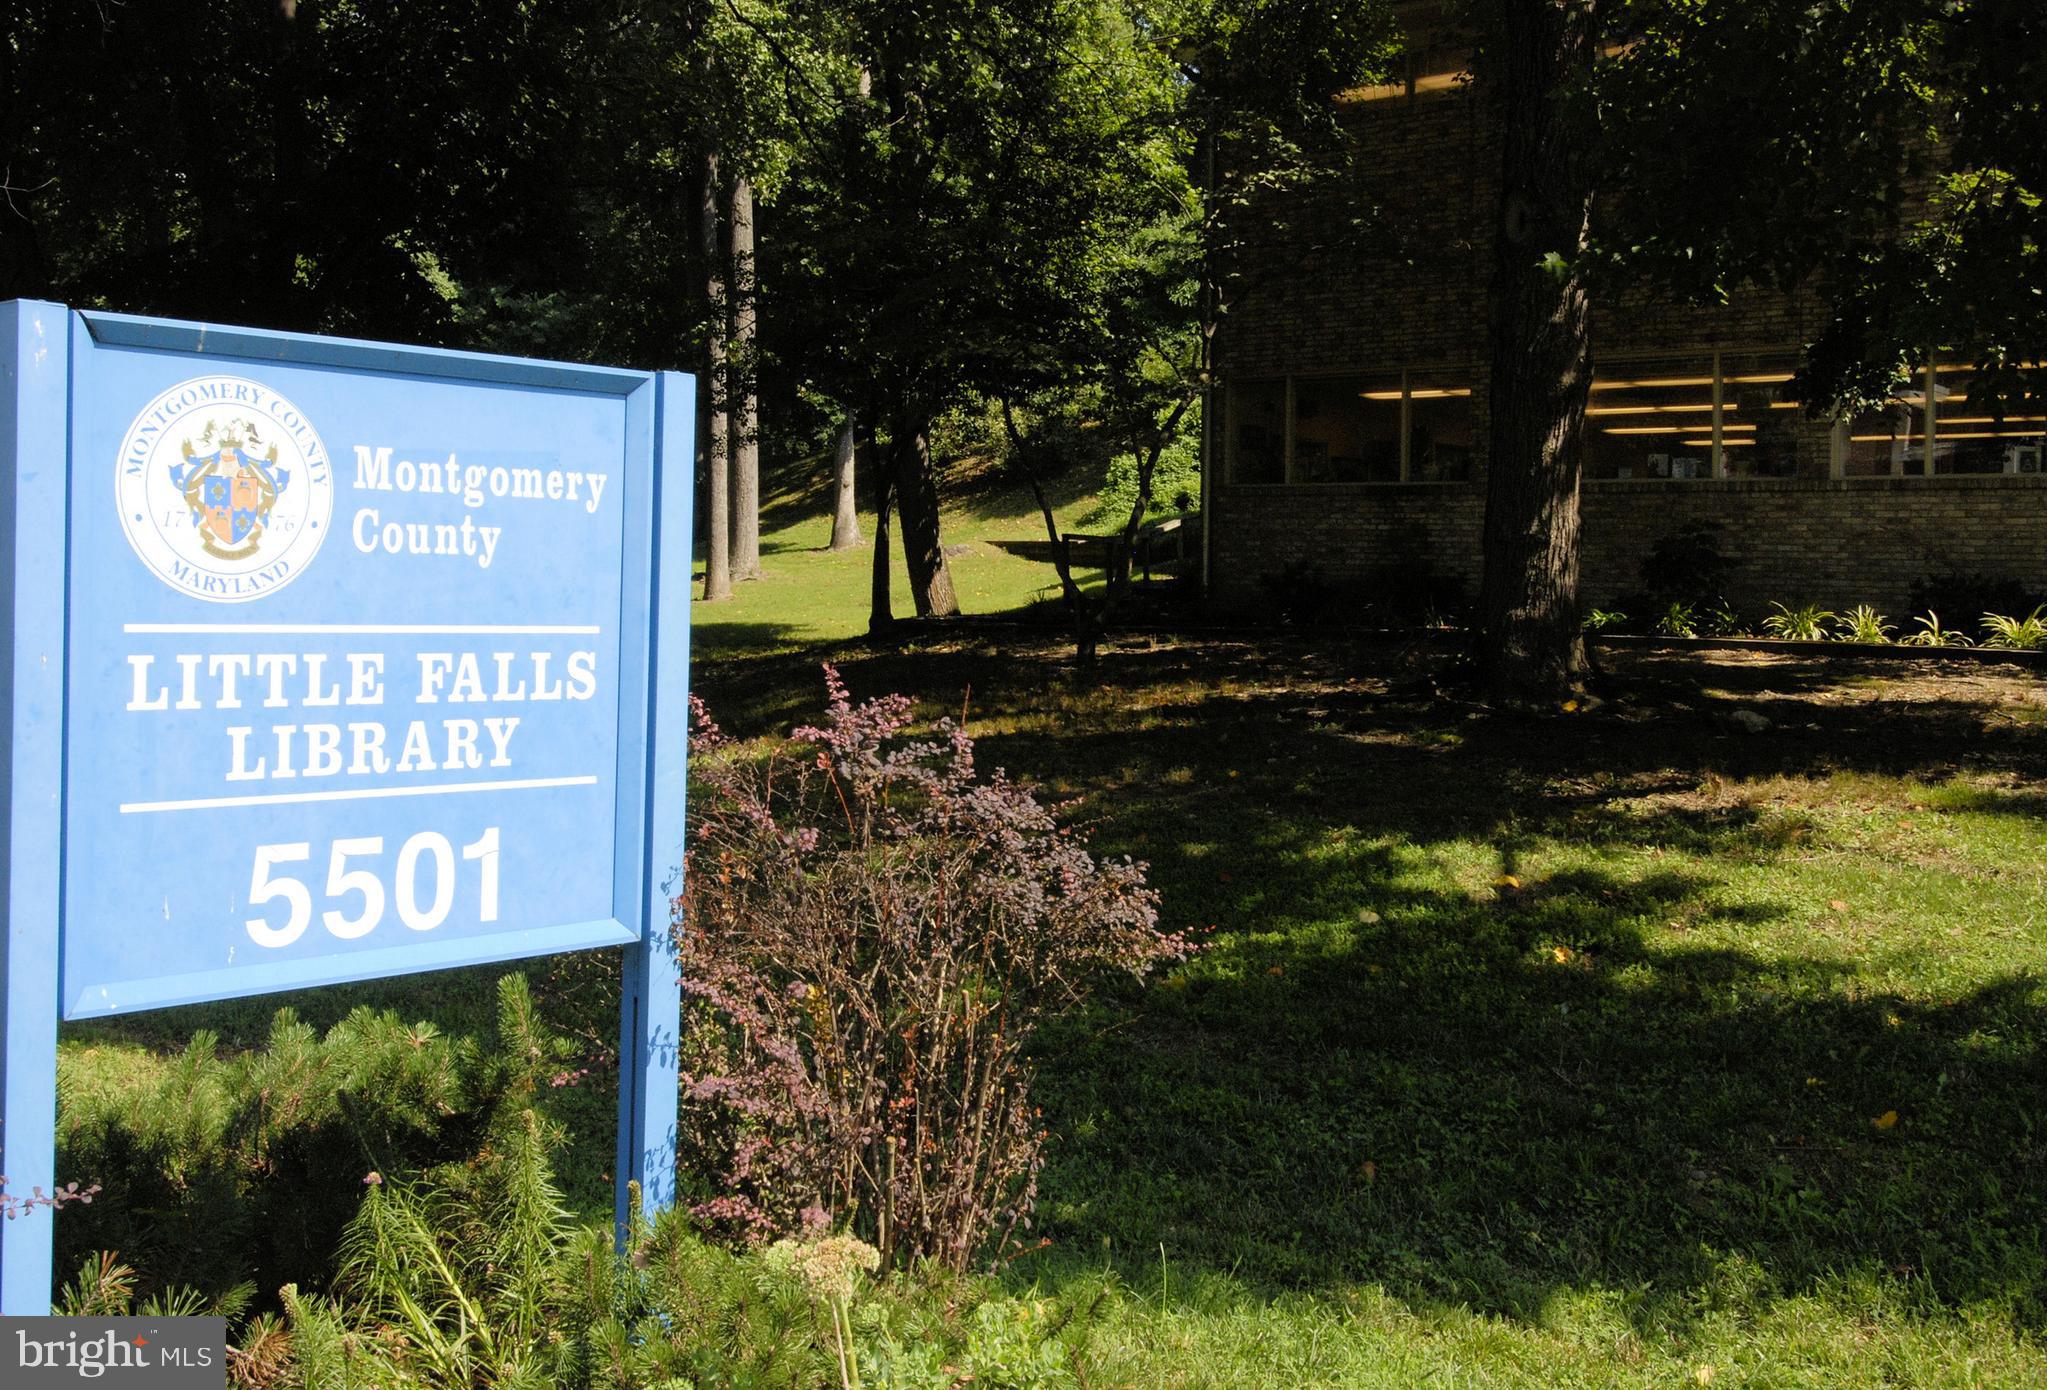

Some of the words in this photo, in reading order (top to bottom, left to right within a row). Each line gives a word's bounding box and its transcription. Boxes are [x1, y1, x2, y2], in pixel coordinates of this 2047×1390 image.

[126, 382, 265, 478] MONTGOMERY
[270, 400, 328, 487] COUNTY
[353, 445, 607, 514] Montgomery
[352, 507, 502, 569] County
[168, 559, 290, 594] MARYLAND
[126, 652, 385, 712] LITTLE
[415, 650, 597, 704] FALLS
[225, 716, 521, 782] LIBRARY
[244, 826, 500, 949] 5501
